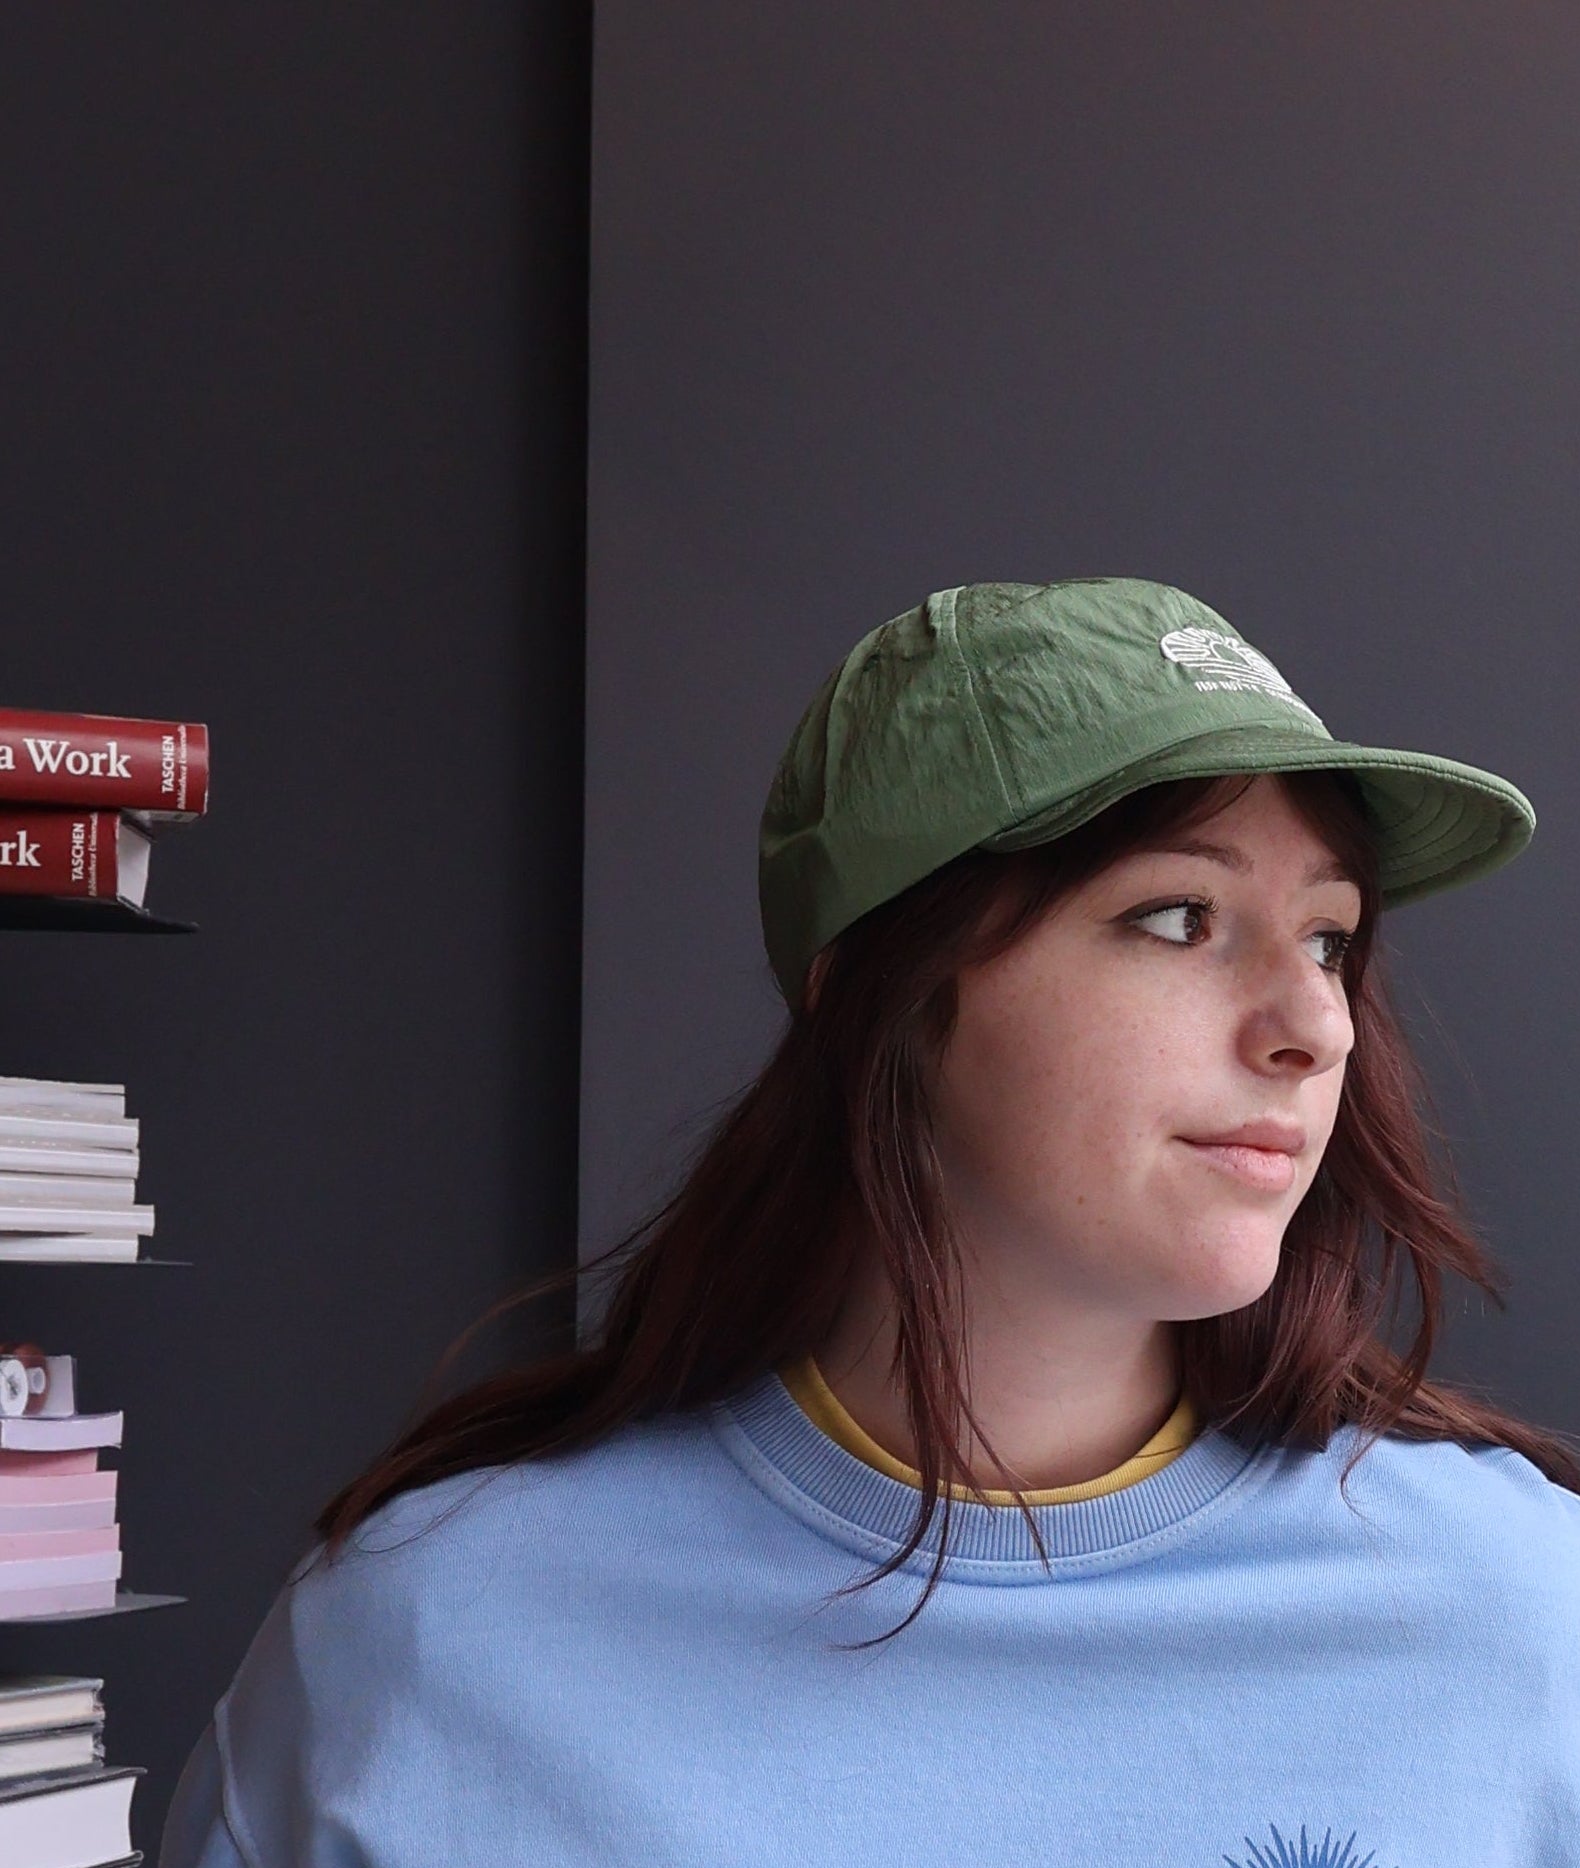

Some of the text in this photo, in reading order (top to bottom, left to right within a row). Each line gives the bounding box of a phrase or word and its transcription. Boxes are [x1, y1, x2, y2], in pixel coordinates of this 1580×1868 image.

[23, 737, 132, 778] Work
[162, 735, 175, 794] TASCHEN
[0, 830, 41, 867] rk
[72, 822, 85, 882] TASCHEN
